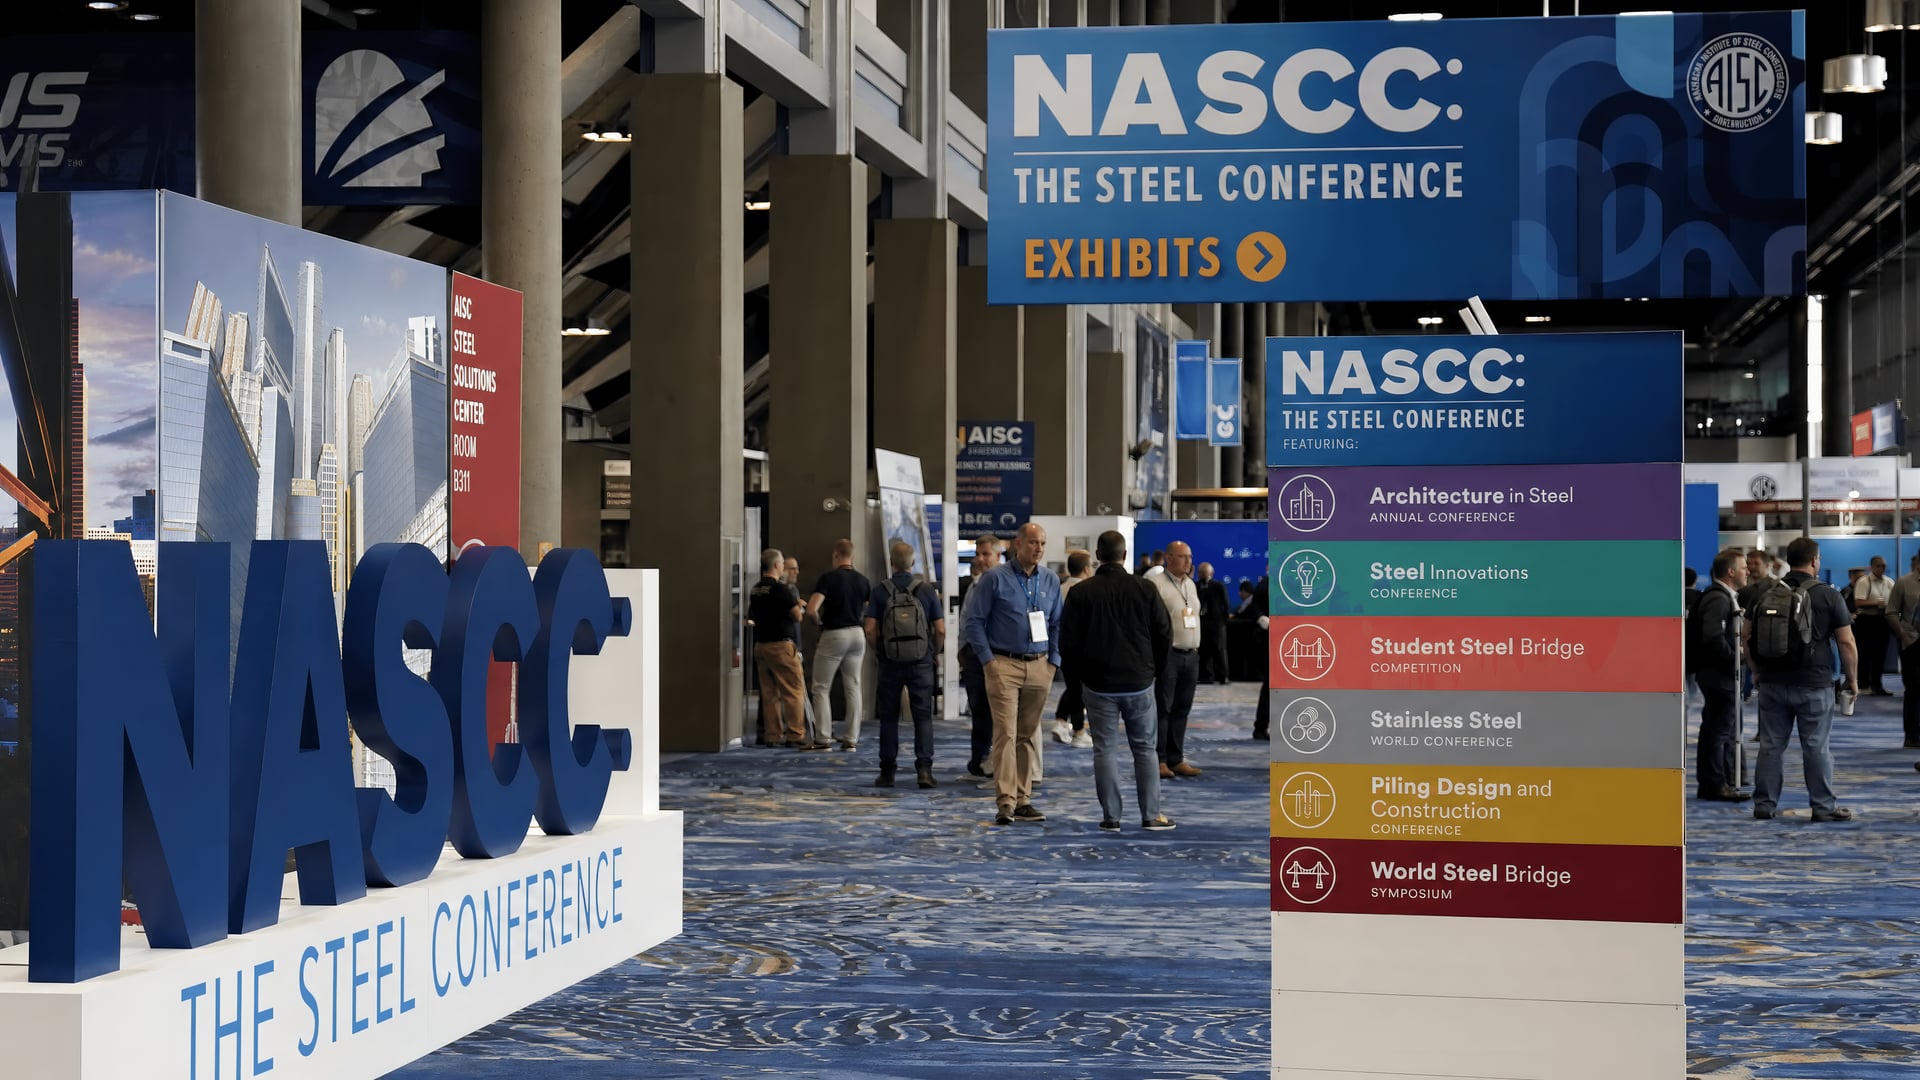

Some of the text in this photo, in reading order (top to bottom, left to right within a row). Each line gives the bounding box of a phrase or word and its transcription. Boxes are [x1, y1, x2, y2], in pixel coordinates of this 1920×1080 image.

[1014, 47, 1462, 137] NASCC:
[1706, 52, 1768, 113] AISC
[1014, 162, 1462, 203] THE STEEL CONFERENCE
[1026, 238, 1220, 278] EXHIBITS
[455, 295, 471, 320] AISC
[454, 329, 476, 355] STEEL
[454, 364, 496, 392] SOLUTIONS
[1283, 348, 1524, 395] NASCC:
[454, 399, 484, 424] CENTER
[1283, 409, 1524, 429] THE STEEL CONFERENCE
[454, 434, 476, 457] ROOM
[968, 426, 1023, 445] AISC
[1284, 439, 1358, 450] FEATURING:
[454, 469, 470, 492] B311
[1370, 487, 1572, 504] Architecture in Steel
[1370, 512, 1514, 523] ANNUAL CONFERENCE
[1371, 562, 1528, 579] Steel Innovations
[1371, 589, 1457, 599] CONFERENCE
[1371, 637, 1584, 659] Student Steel Bridge
[1371, 663, 1460, 674] COMPETITION
[1371, 711, 1521, 729] Stainless Steel
[1371, 736, 1512, 748] WORLD CONFERENCE
[1372, 777, 1551, 800] Piling Design and
[1372, 800, 1500, 819] Construction
[1371, 824, 1461, 836] CONFERENCE
[1371, 862, 1570, 887] World Steel Bridge
[1372, 888, 1451, 900] SYMPOSIUM
[181, 846, 624, 1080] THE STEEL CONFERENCE
